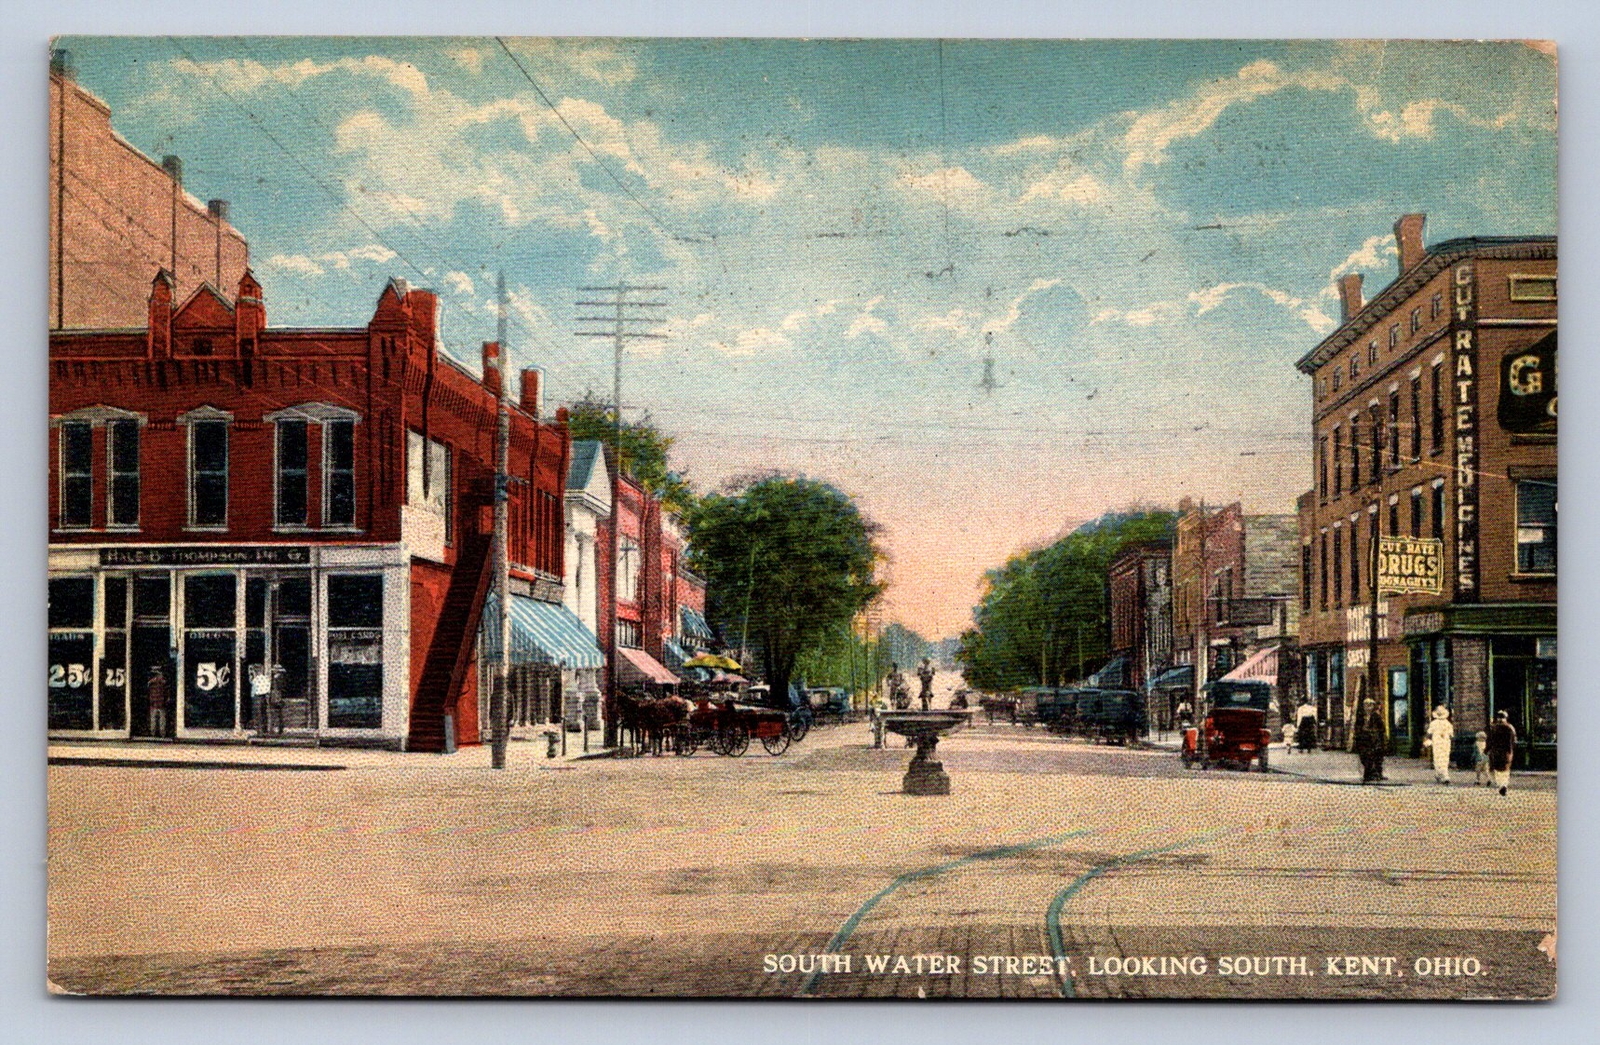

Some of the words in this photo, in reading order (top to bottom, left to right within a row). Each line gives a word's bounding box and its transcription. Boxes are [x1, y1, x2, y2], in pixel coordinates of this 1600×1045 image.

[1455, 265, 1472, 320] CUT
[1456, 330, 1473, 430] RATE
[1457, 436, 1475, 590] MEDICINES
[1379, 554, 1438, 576] DRUGS
[1380, 541, 1401, 552] CUT
[1406, 543, 1435, 555] RATE
[197, 661, 231, 691] 5¢
